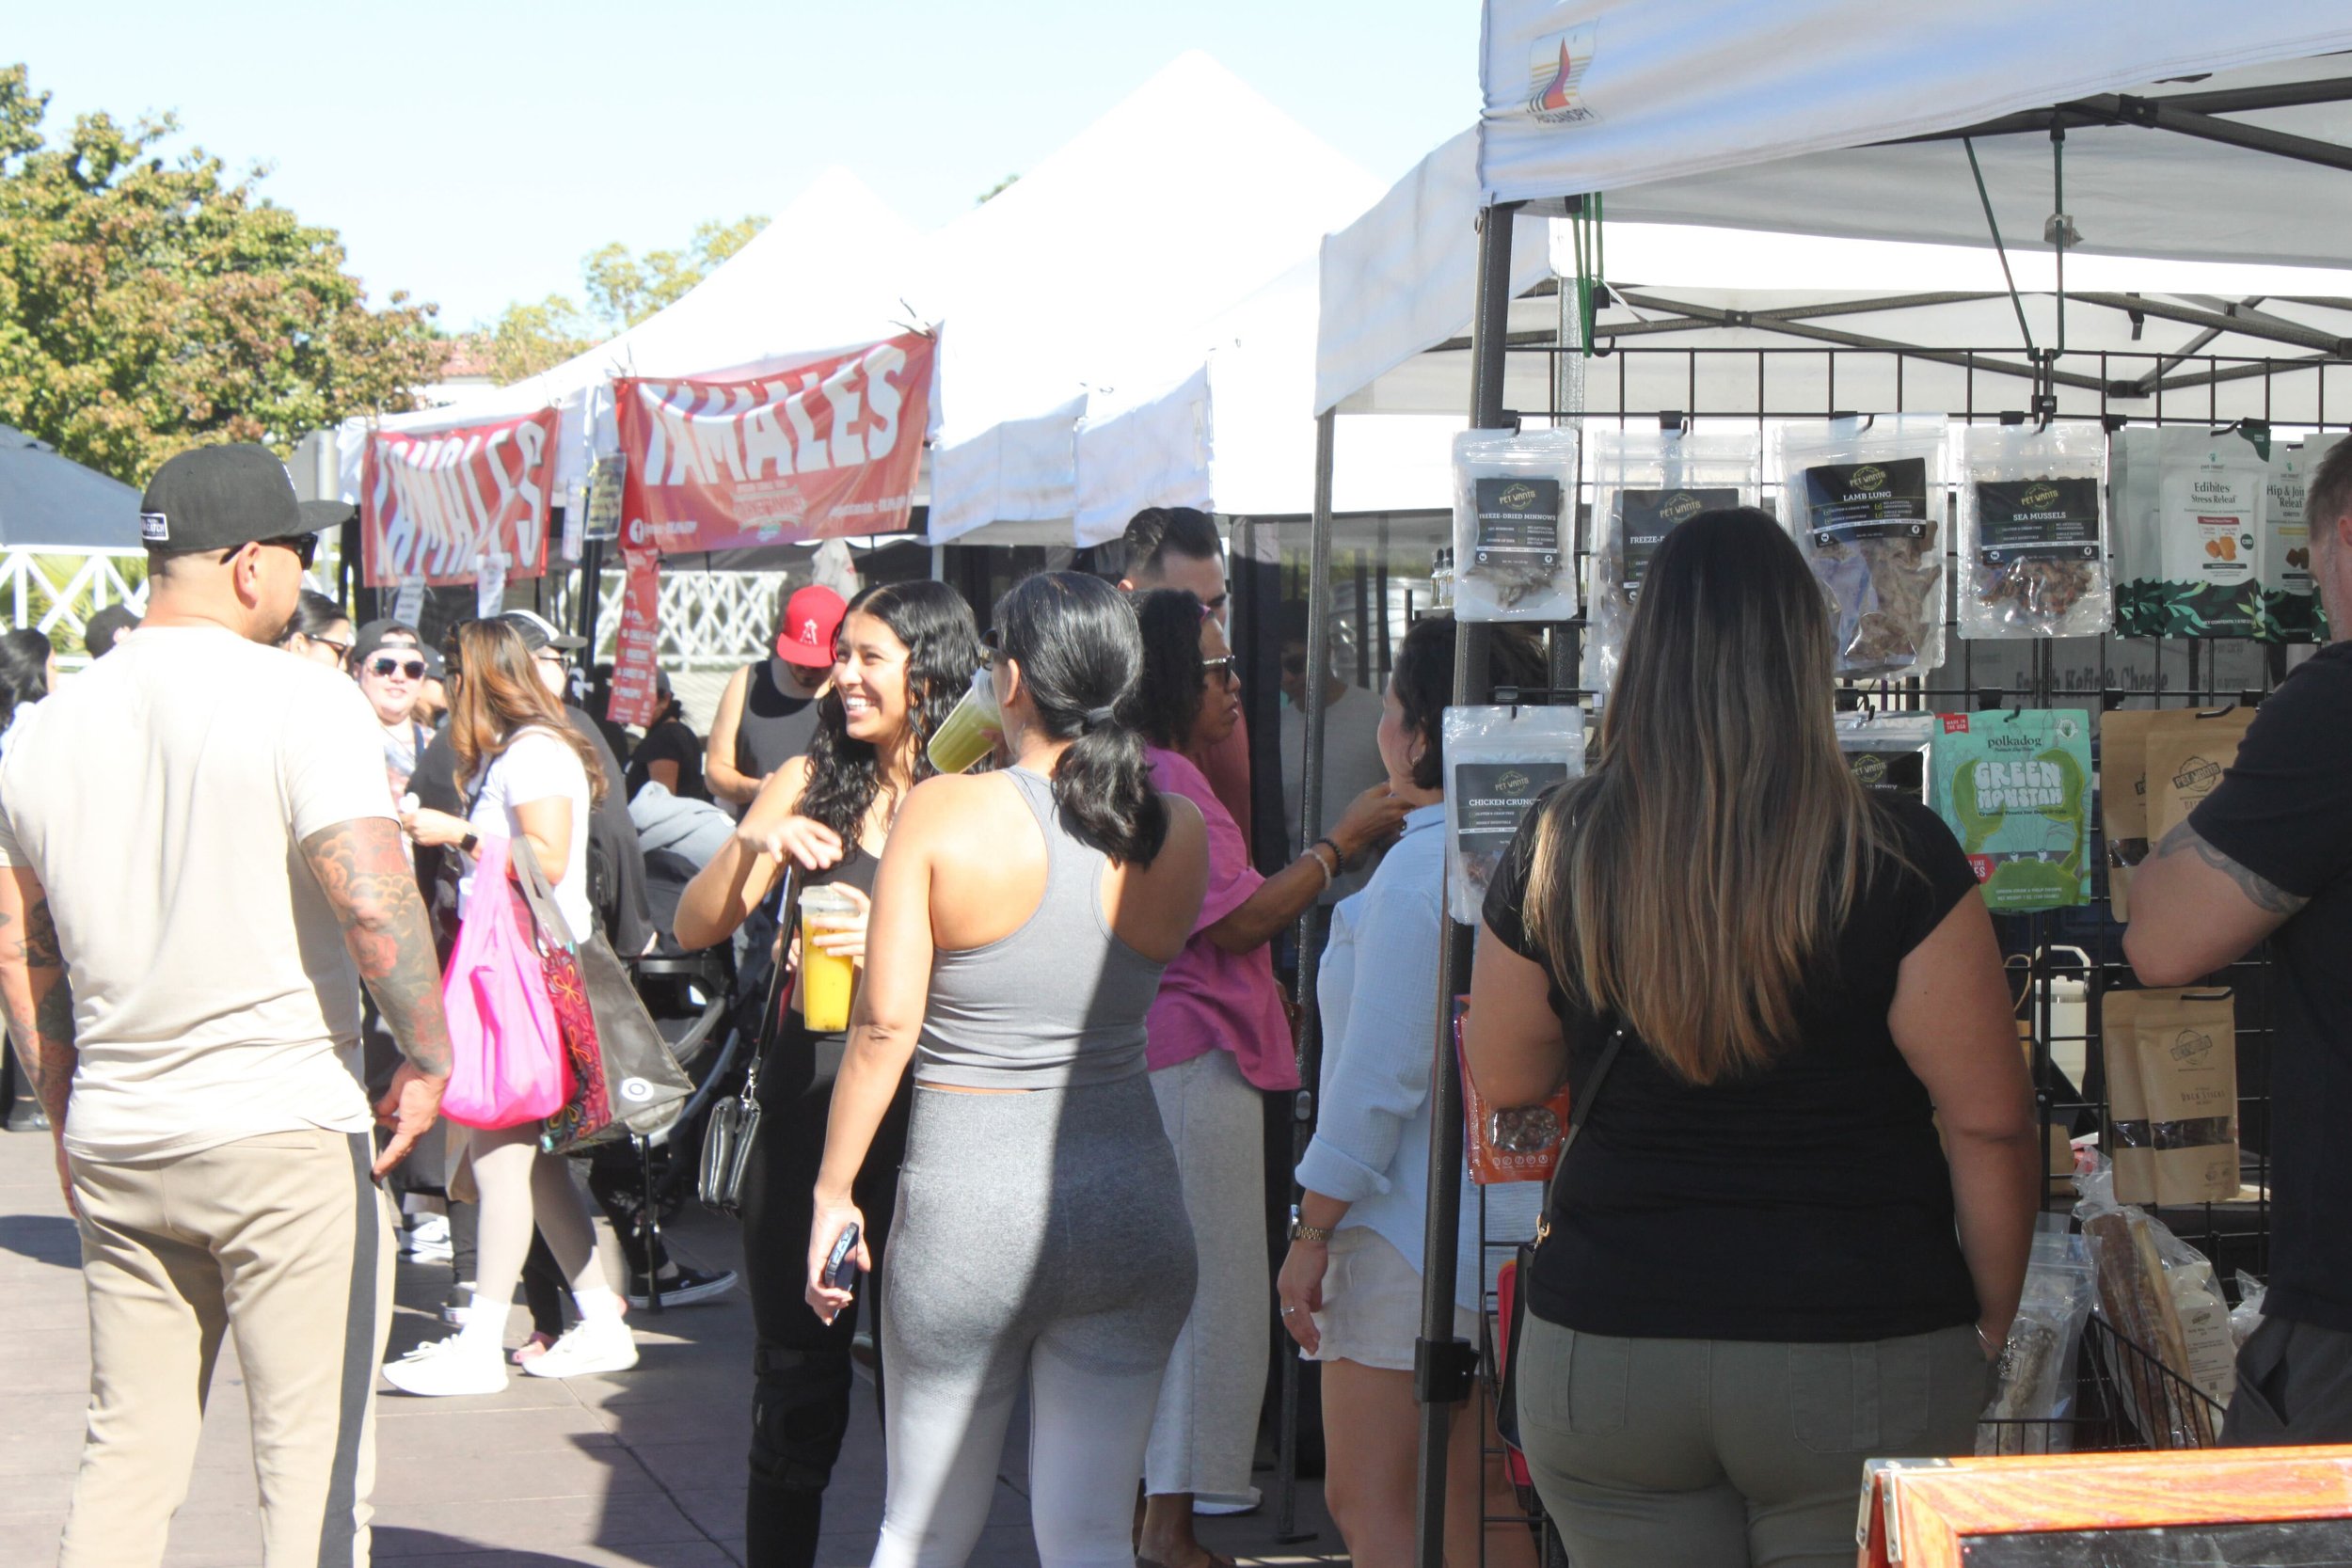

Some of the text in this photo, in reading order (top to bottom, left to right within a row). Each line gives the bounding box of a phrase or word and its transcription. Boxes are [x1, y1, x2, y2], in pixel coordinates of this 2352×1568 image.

[639, 343, 906, 485] TAMALES
[1849, 477, 1862, 487] PET
[2194, 482, 2231, 493] Edibites
[1843, 491, 1892, 501] LAMB LUNG
[2266, 484, 2282, 499] Hip
[2284, 485, 2290, 497] &
[373, 420, 545, 577] TAMALES
[1499, 495, 1512, 505] PET
[2021, 497, 2034, 506] PET
[2191, 495, 2236, 504] Stress Releaf
[2280, 497, 2303, 508] Releaf
[1660, 500, 1701, 518] PET WANTS
[2013, 511, 2067, 521] SEA MUSSELS
[1987, 735, 2042, 749] polkadog
[1974, 761, 2062, 789] GREEN
[2175, 764, 2219, 787] PET WANTS
[1495, 783, 1506, 791] PET
[1469, 798, 1537, 807] CHICKEN CRUNC
[1978, 787, 2063, 809] MONSTAH
